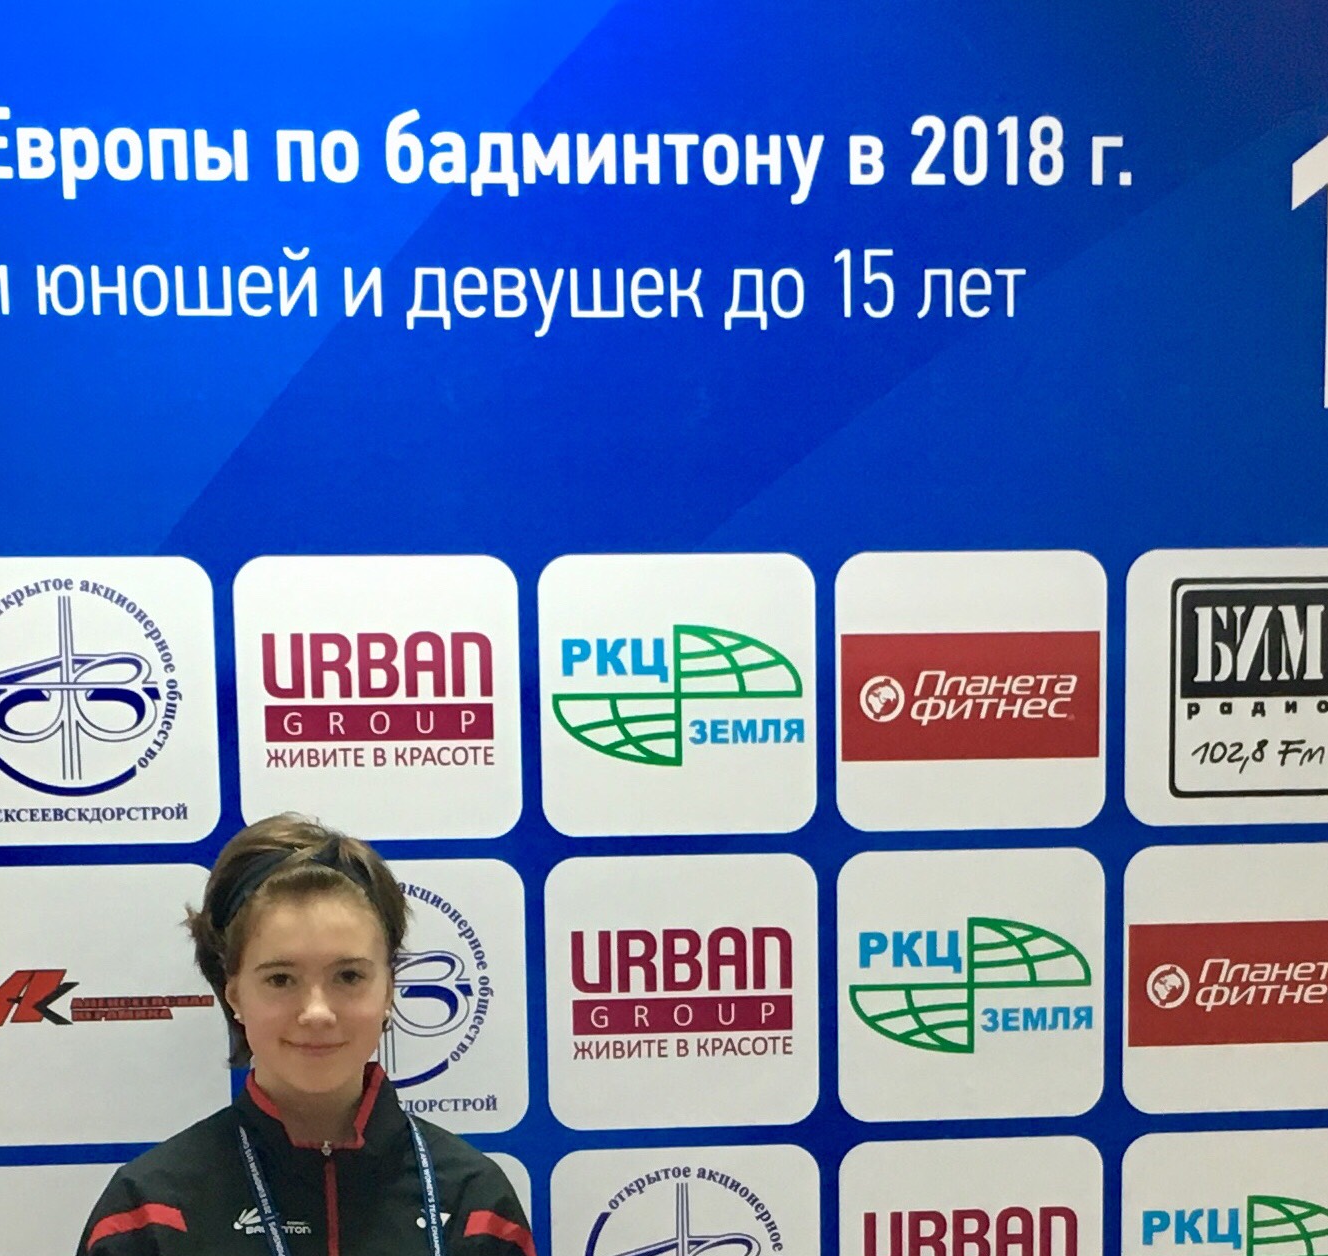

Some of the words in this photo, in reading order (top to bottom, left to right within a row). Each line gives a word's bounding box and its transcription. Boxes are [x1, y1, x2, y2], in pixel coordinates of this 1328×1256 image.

[277, 130, 359, 183] по
[386, 109, 824, 204] бадминтону
[850, 135, 884, 185] в
[911, 115, 1063, 185] 2018
[1092, 136, 1131, 185] г.
[37, 247, 317, 316] юношей
[344, 267, 382, 317] и
[407, 267, 703, 337] девушек
[725, 268, 804, 330] до
[835, 249, 894, 318] 15
[917, 268, 1026, 318] лет
[560, 637, 668, 685] РКЦ
[1193, 604, 1326, 683] БИМ
[261, 630, 493, 700] URBAN
[913, 668, 1077, 696] Планета
[283, 709, 476, 736] GROUP
[910, 695, 1071, 726] фитнес
[688, 717, 805, 745] ЗЕМЛЯ
[265, 747, 365, 768] ЖИВИТЕ
[373, 747, 386, 767] В
[394, 745, 495, 766] КРАСОТЕ
[1190, 738, 1269, 775] 102,8
[570, 925, 793, 994] URBAN
[858, 929, 962, 977] РКЦ
[590, 1001, 776, 1029] GROUP
[981, 1005, 1093, 1033] ЗЕМЛЯ
[572, 1039, 669, 1060] ЖИВИТЕ
[676, 1038, 689, 1057] В
[697, 1036, 793, 1057] КРАСОТЕ
[1142, 1207, 1243, 1254] РКЦ
